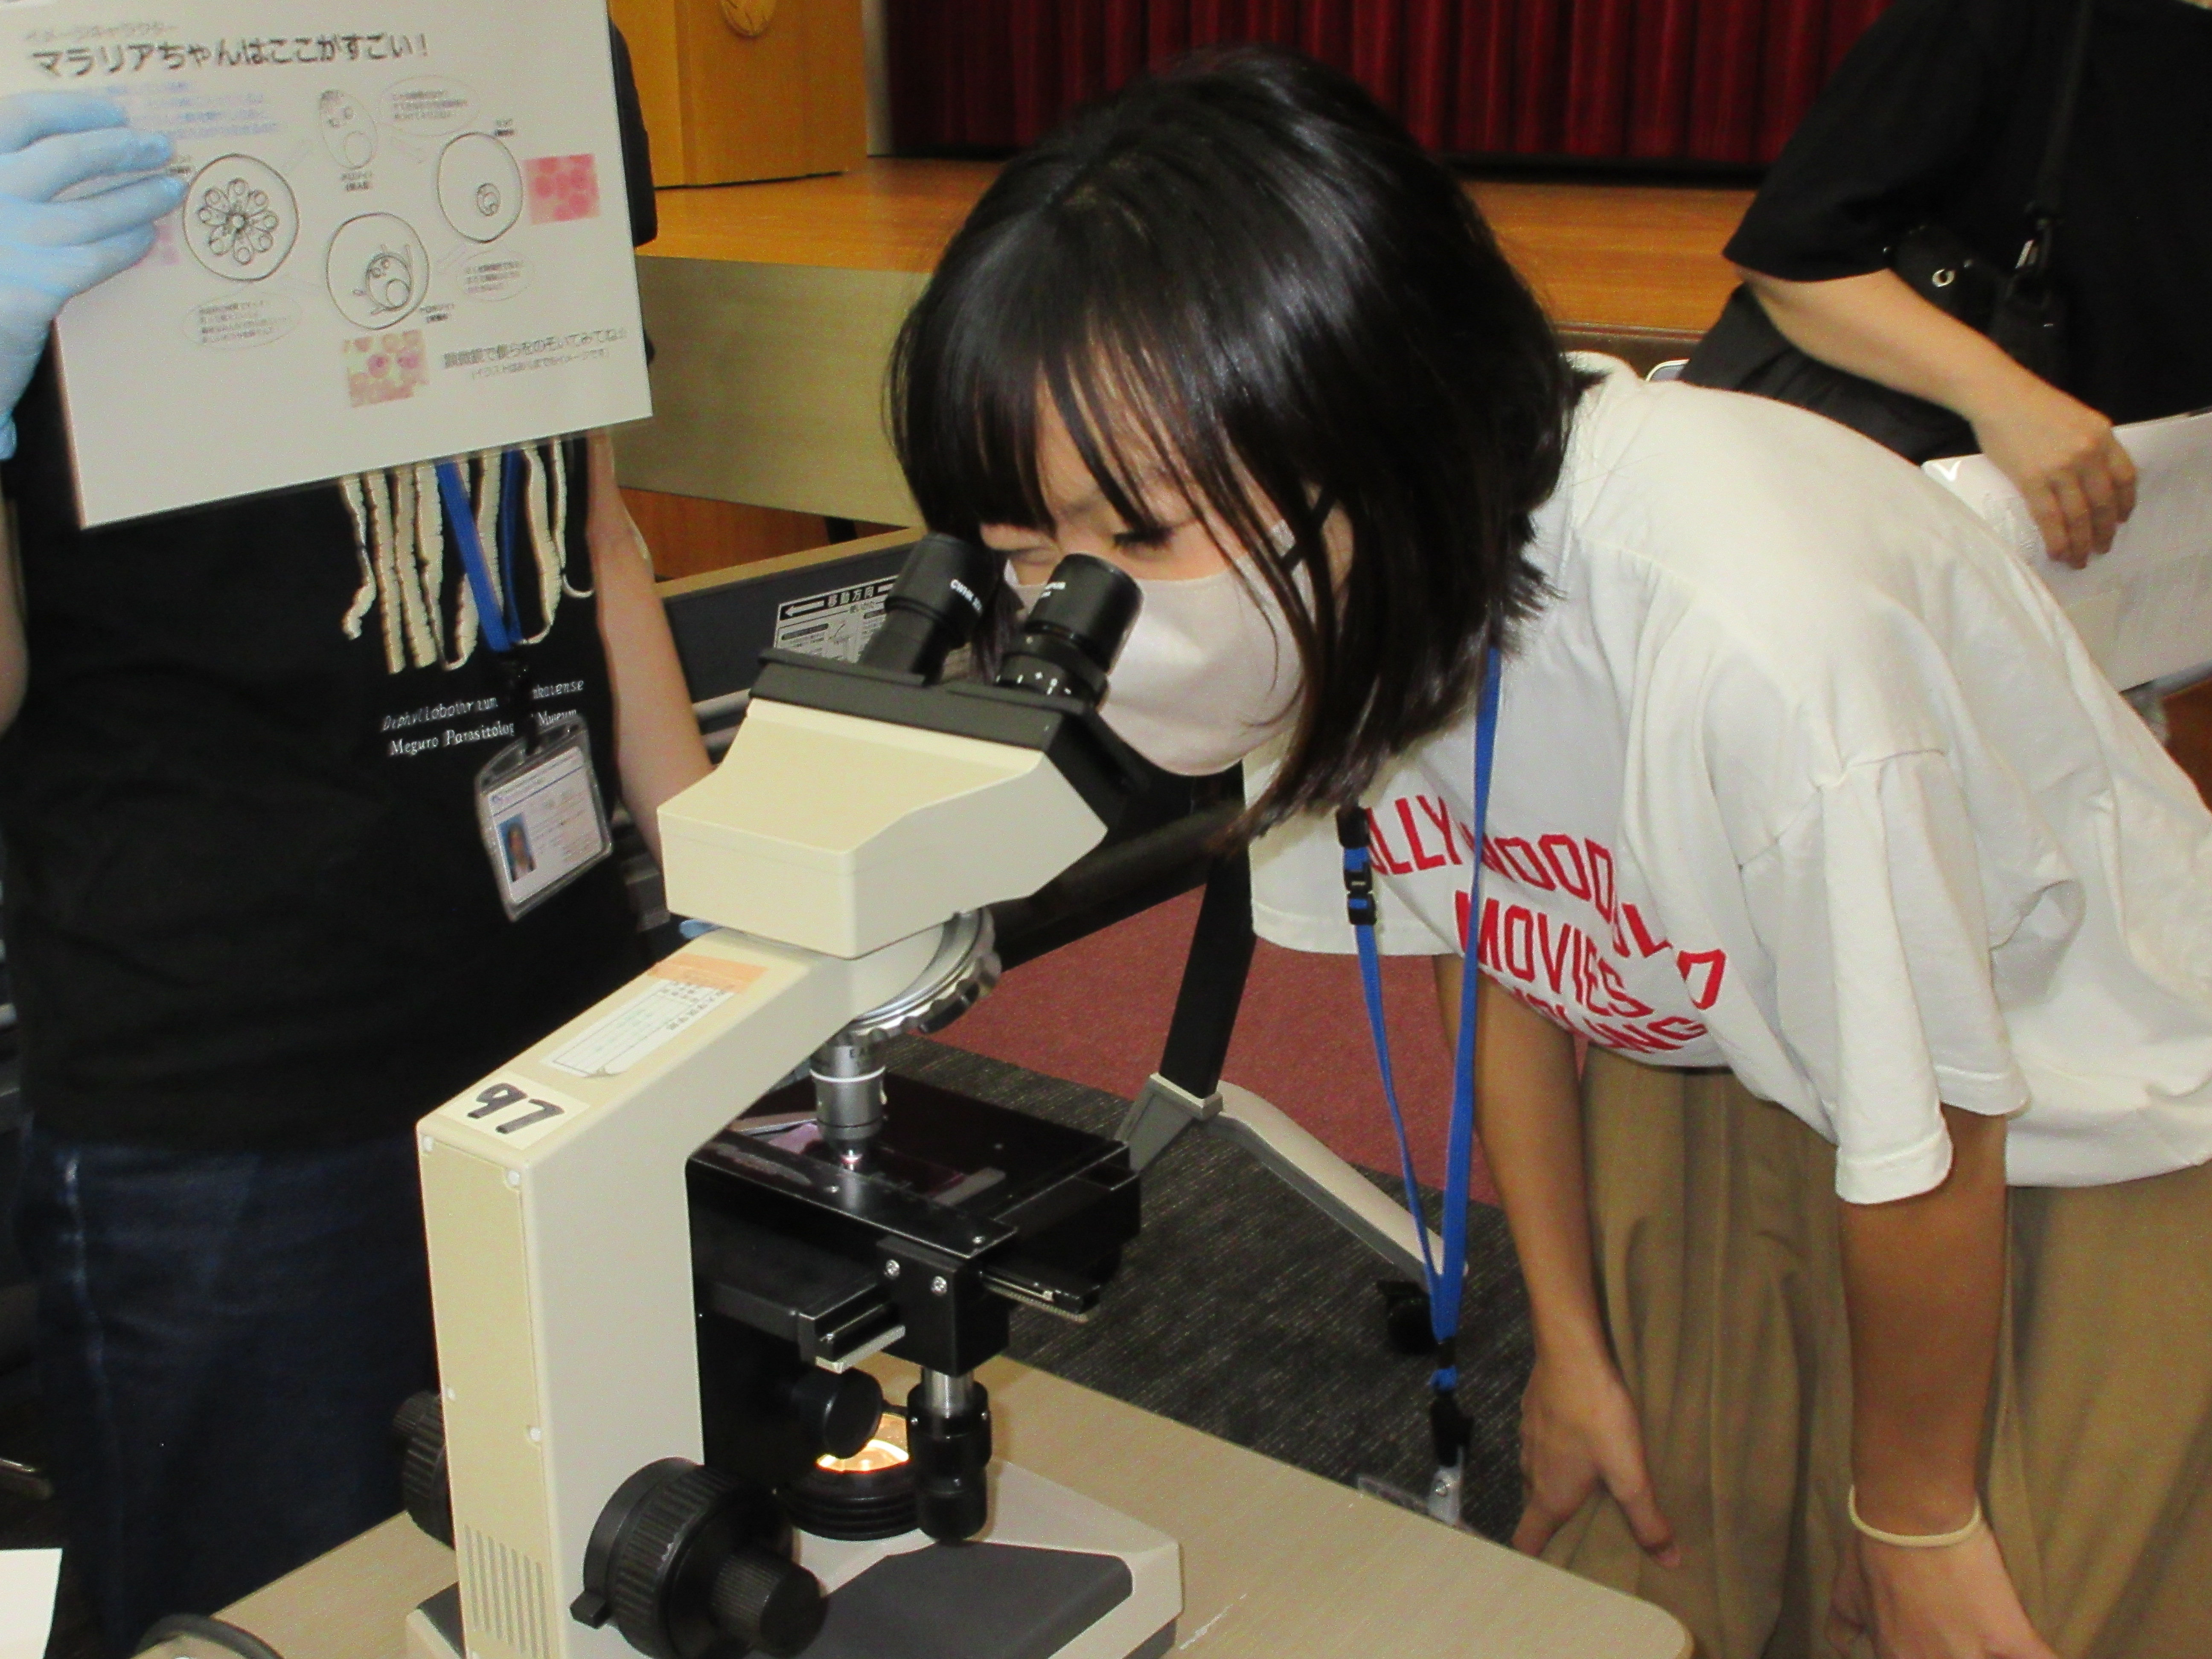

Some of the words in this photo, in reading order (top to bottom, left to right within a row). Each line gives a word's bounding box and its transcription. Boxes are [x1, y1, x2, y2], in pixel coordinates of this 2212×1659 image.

[828, 585, 875, 608] 移動方向
[389, 736, 439, 756] Meguro
[1455, 890, 1654, 1019] MOVIES
[467, 1082, 565, 1135] 97
